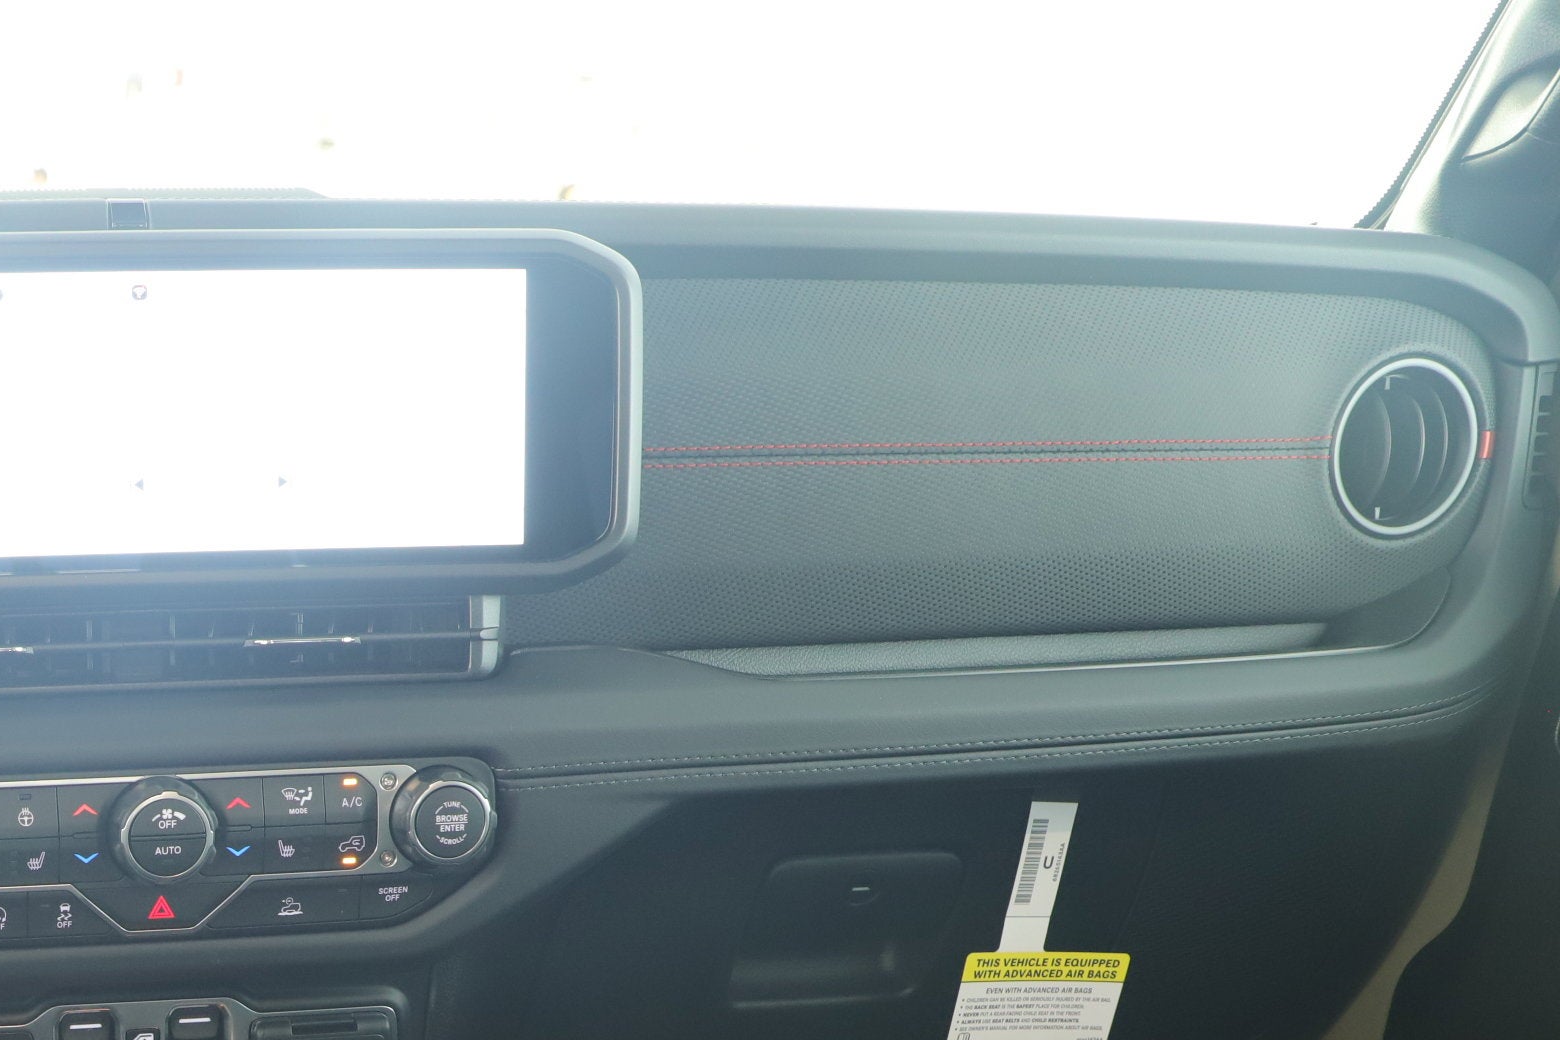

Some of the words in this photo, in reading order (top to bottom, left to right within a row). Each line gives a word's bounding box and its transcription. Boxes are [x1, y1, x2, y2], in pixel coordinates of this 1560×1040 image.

[341, 797, 363, 808] A/C
[443, 800, 462, 810] TUNE
[288, 807, 308, 815] MODE
[435, 814, 469, 823] BROWSE
[158, 820, 178, 829] OFF
[440, 823, 465, 832] ENTER
[439, 834, 465, 846] SCROLL
[154, 845, 182, 856] AUTO
[1043, 855, 1055, 870] U
[378, 886, 409, 895] SCREEN
[385, 894, 401, 902] OFF
[56, 921, 73, 929] OFF
[976, 957, 1000, 968] THIS
[1003, 957, 1048, 968] VEHICLE
[1051, 957, 1061, 968] IS
[1064, 958, 1120, 968] EQUIPPED
[973, 969, 1001, 979] WITH
[1003, 969, 1064, 978] ADVANCED
[1065, 969, 1085, 979] AIR
[1087, 969, 1117, 979] BAGS
